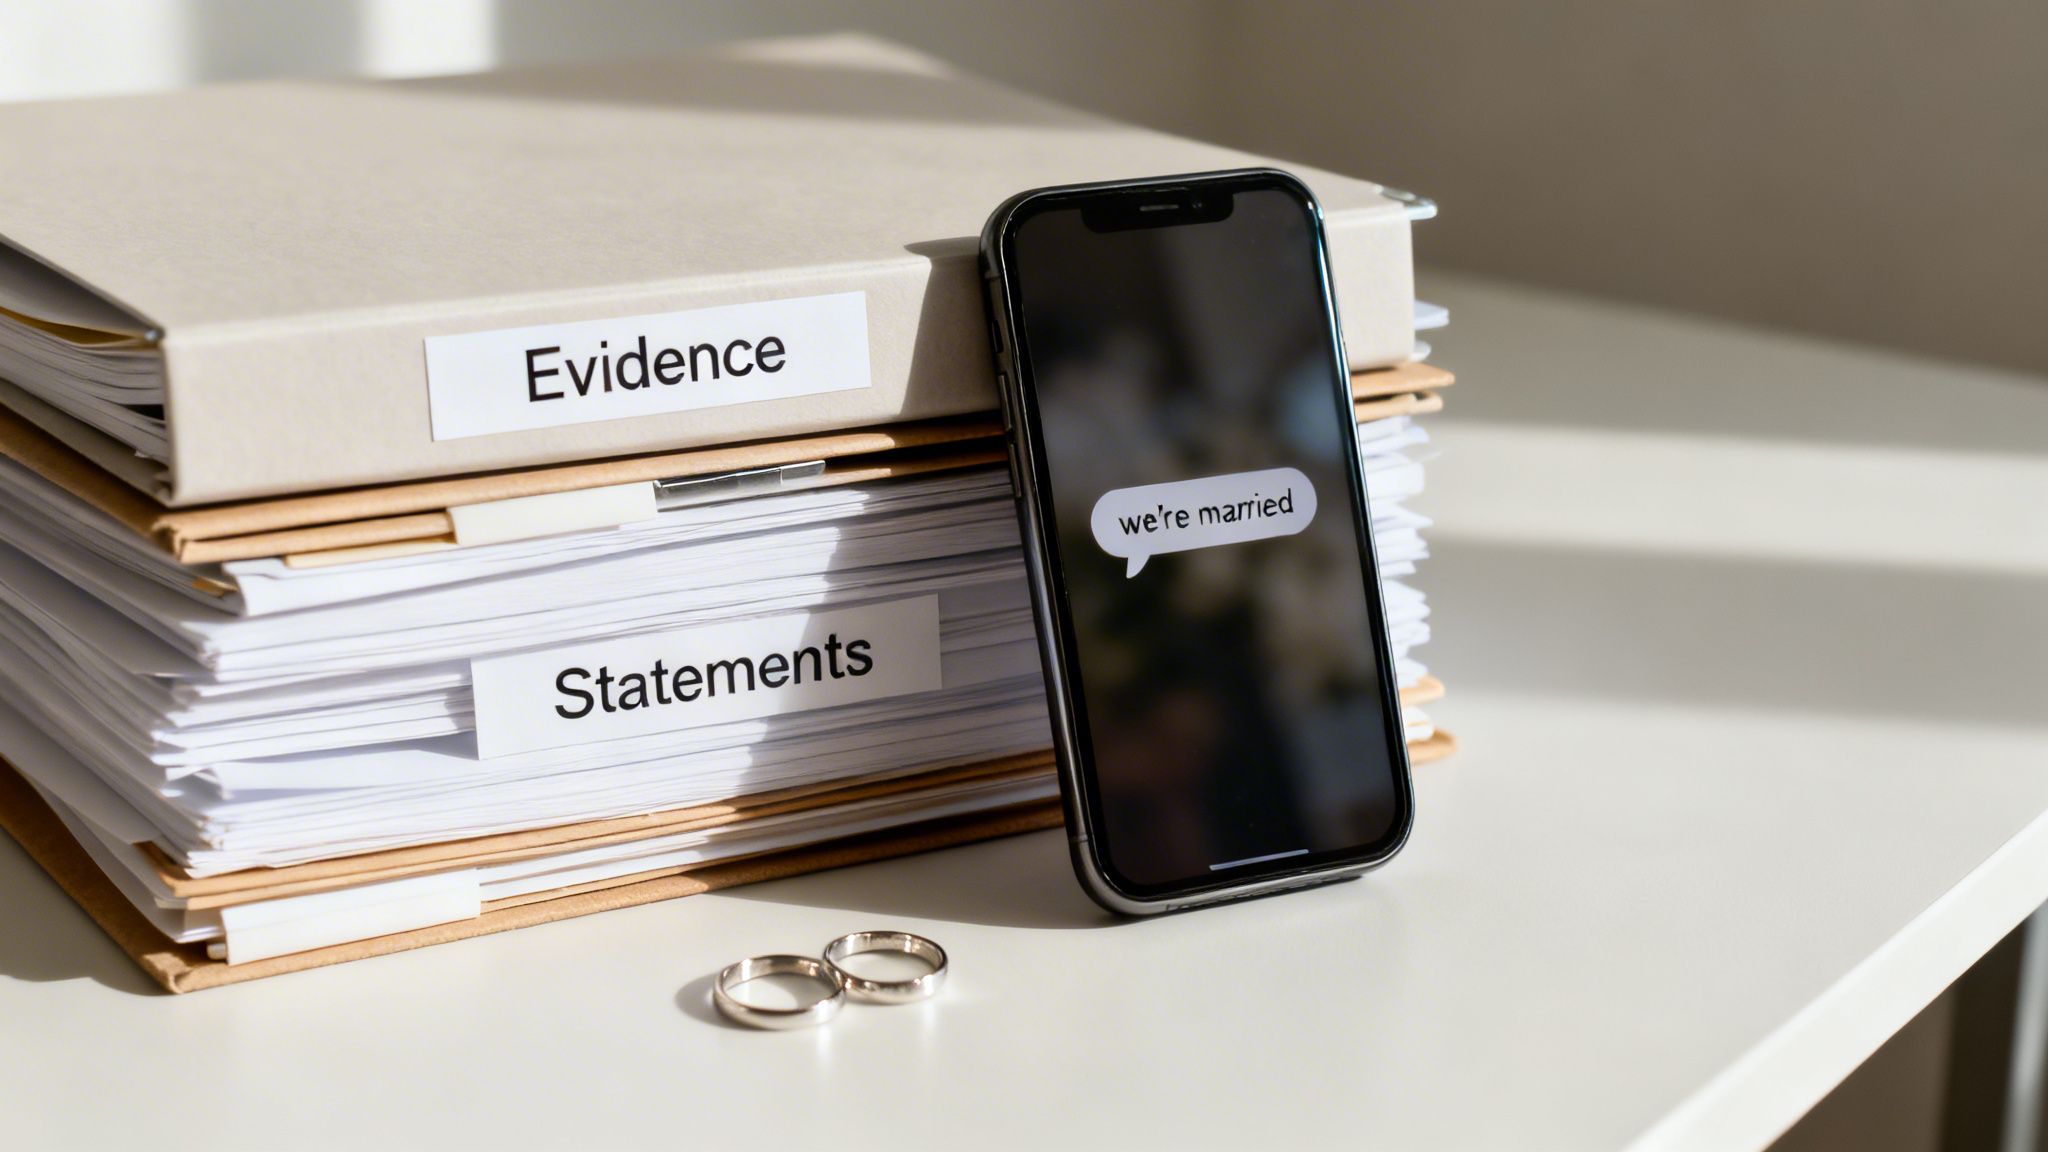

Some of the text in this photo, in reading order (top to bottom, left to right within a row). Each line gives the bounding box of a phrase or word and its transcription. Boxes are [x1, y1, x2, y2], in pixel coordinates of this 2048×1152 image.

[525, 335, 786, 403] Evidence
[1118, 487, 1294, 536] we're married
[555, 632, 874, 720] Statements
